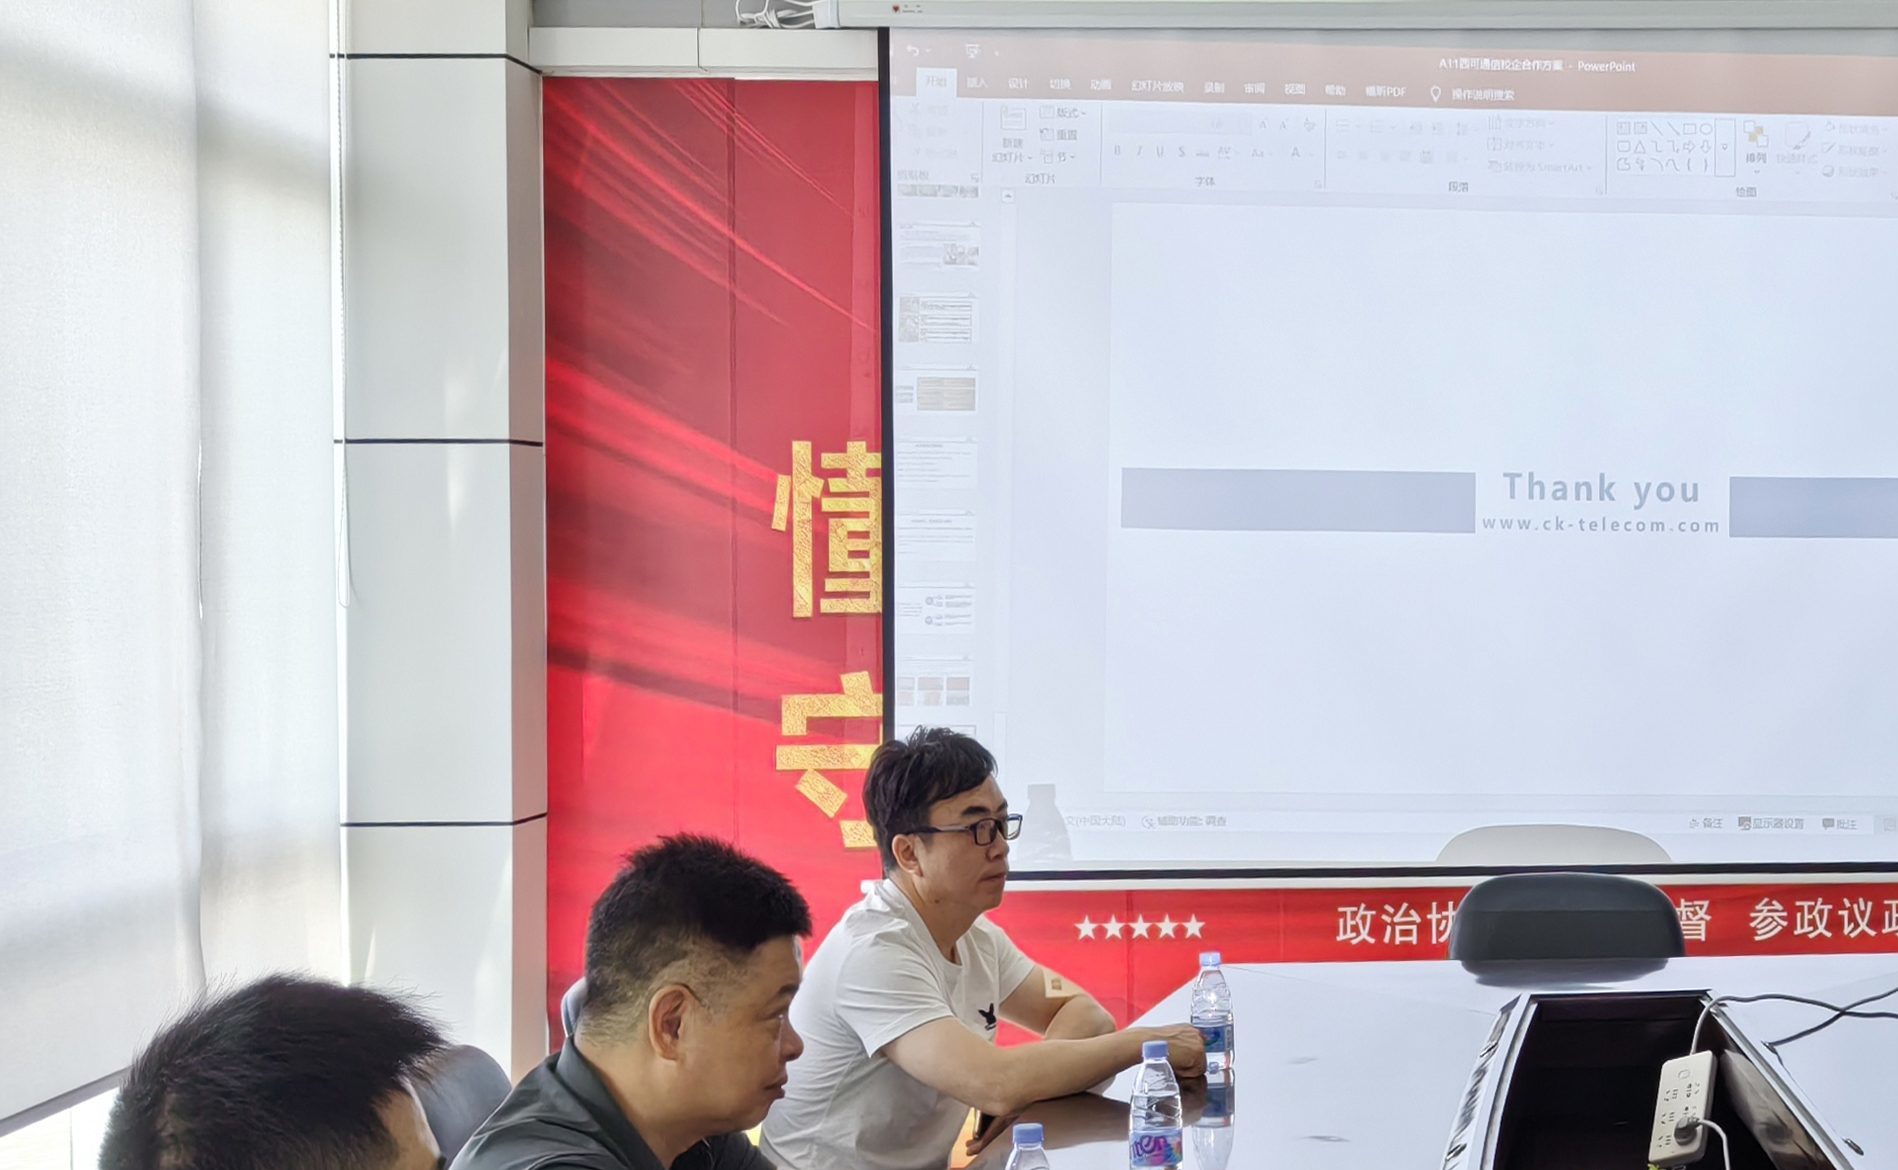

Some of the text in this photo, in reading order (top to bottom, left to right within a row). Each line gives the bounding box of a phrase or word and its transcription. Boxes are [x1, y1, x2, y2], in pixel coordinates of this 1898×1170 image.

[1578, 61, 1636, 72] PowerPoint
[1502, 471, 1702, 511] Thank you
[1481, 513, 1720, 535] www.ck-telecom.com
